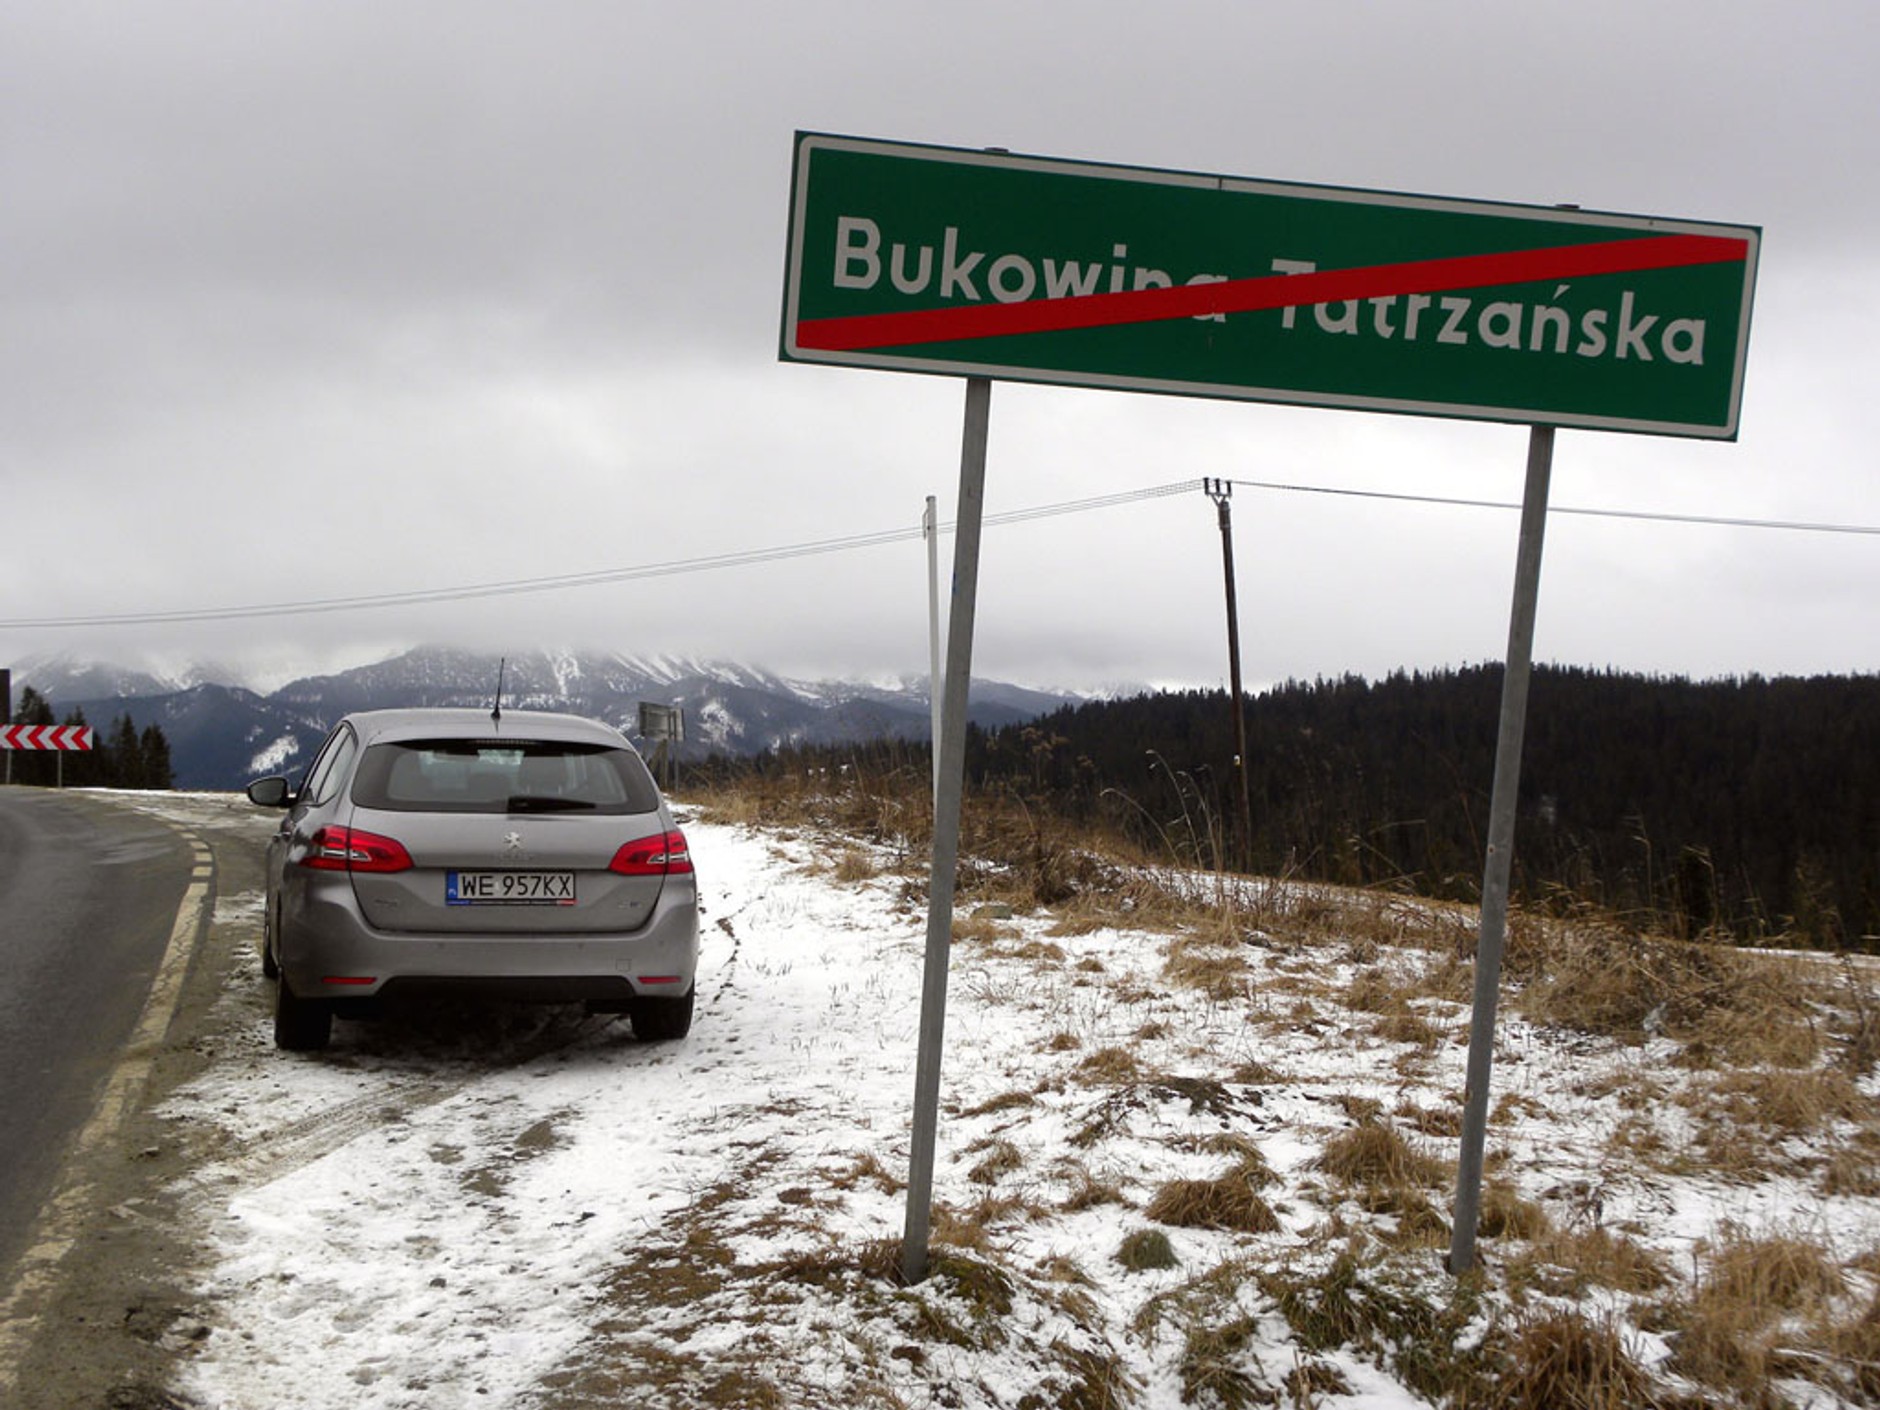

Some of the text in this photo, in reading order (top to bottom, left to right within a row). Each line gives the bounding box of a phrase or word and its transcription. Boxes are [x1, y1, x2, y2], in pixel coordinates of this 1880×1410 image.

[1271, 258, 1706, 365] Tatrzańska
[462, 875, 571, 897] WE 957KX
